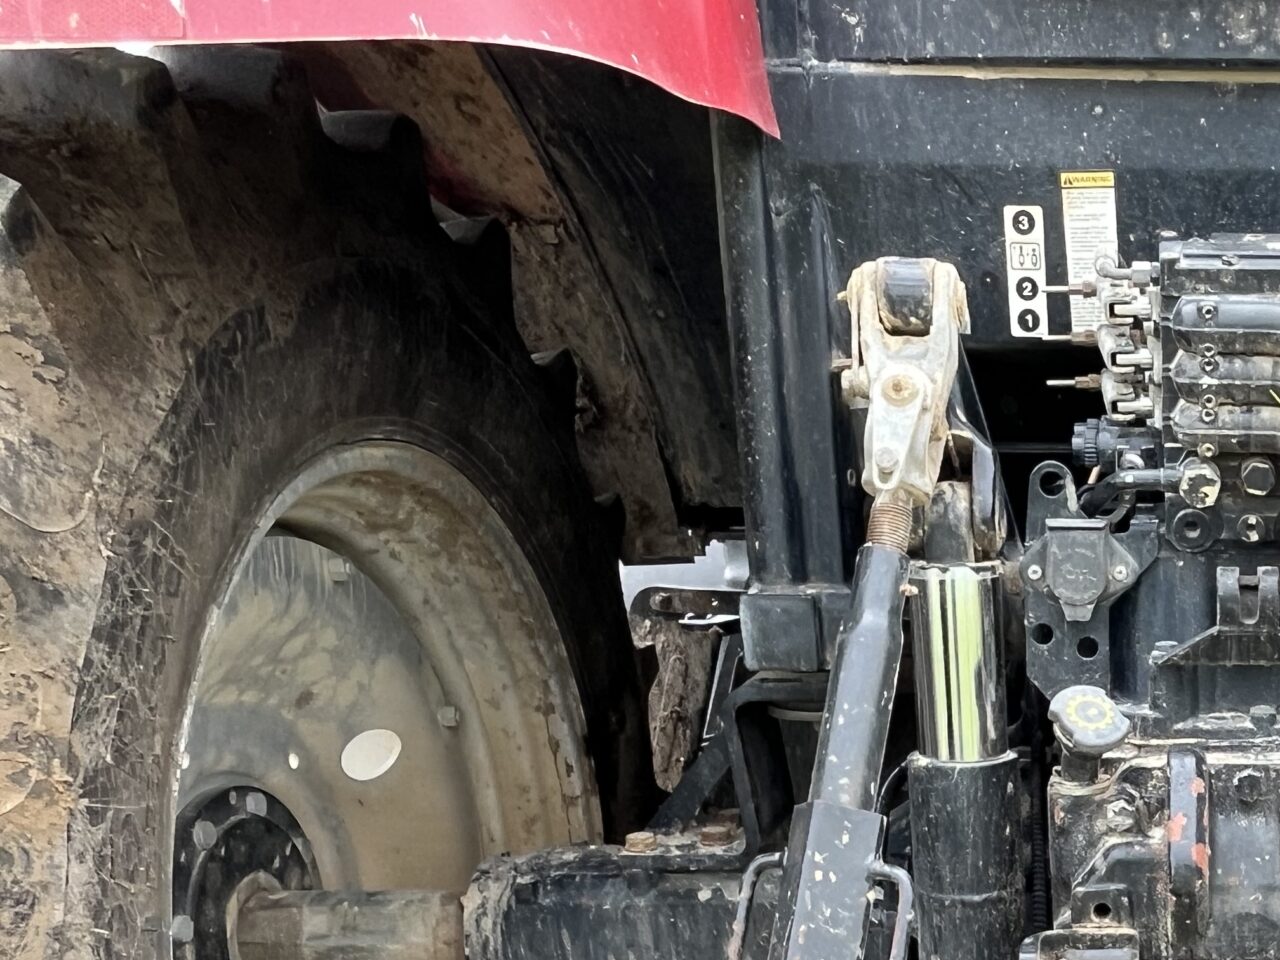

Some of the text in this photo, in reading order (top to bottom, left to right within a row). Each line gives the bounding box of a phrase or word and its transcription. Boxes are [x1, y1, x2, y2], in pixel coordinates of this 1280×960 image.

[1071, 175, 1112, 183] WARNING
[1017, 215, 1029, 230] 3
[1022, 282, 1033, 296] 2
[1025, 314, 1033, 328] 1
